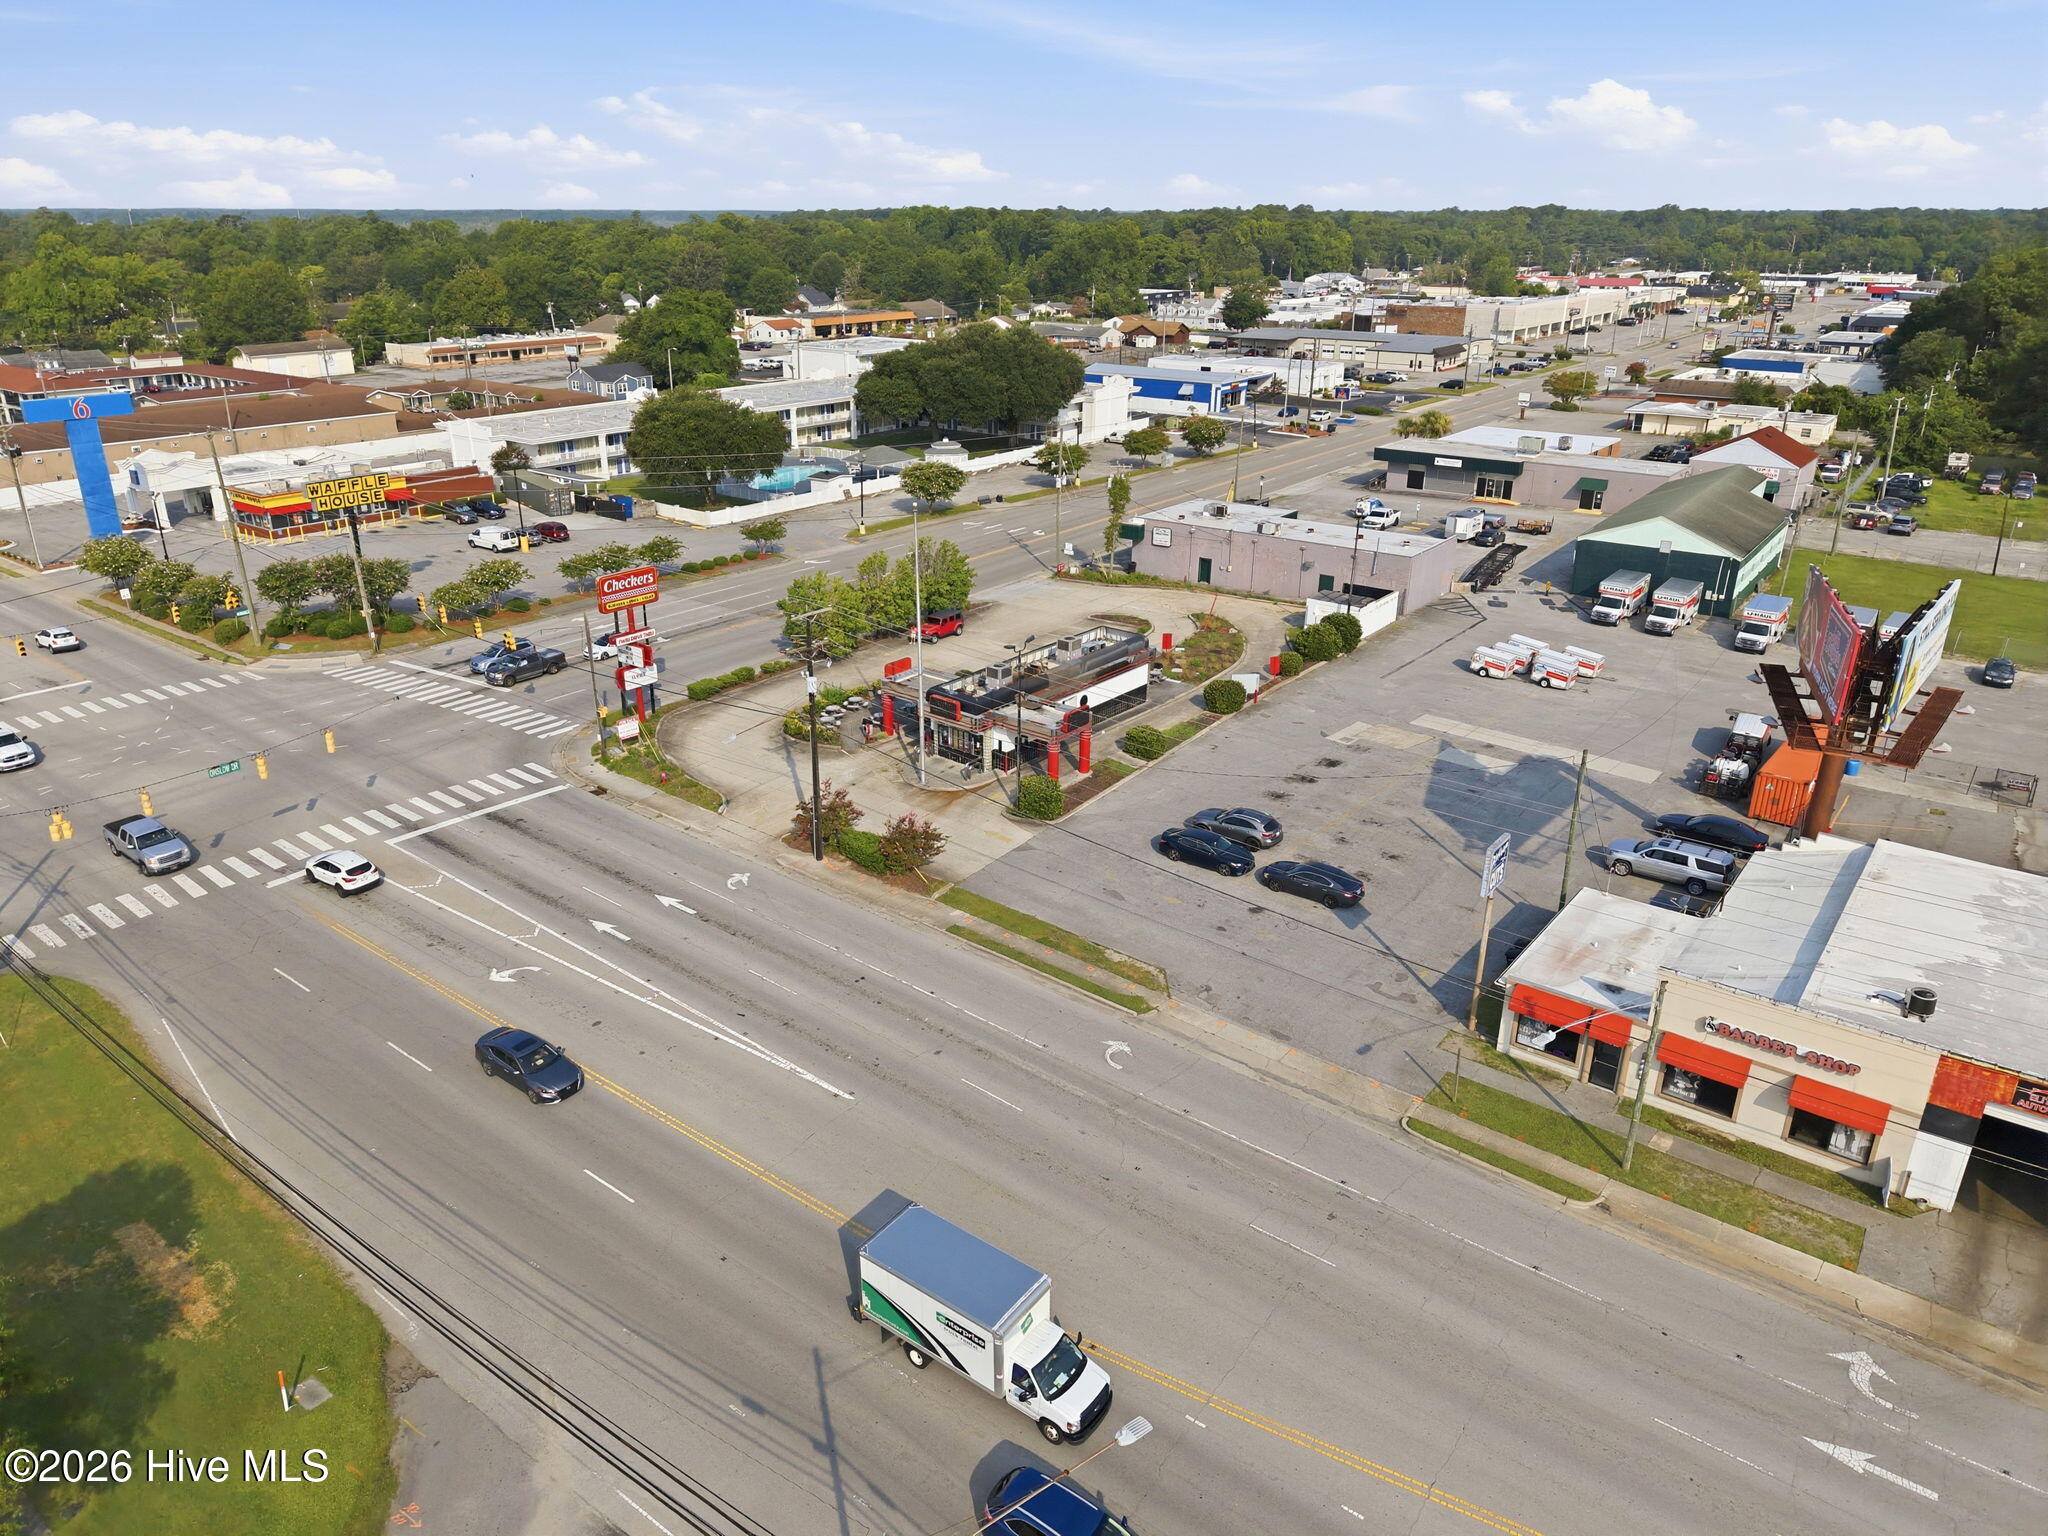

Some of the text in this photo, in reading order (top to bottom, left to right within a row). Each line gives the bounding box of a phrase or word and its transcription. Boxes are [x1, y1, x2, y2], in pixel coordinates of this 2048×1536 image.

[73, 396, 91, 419] 6
[309, 476, 386, 496] WAFFLE
[319, 490, 382, 510] HOUSE
[603, 573, 654, 593] Checkers
[1718, 1022, 1862, 1077] BARBER SHOP
[938, 1314, 985, 1347] enterprise
